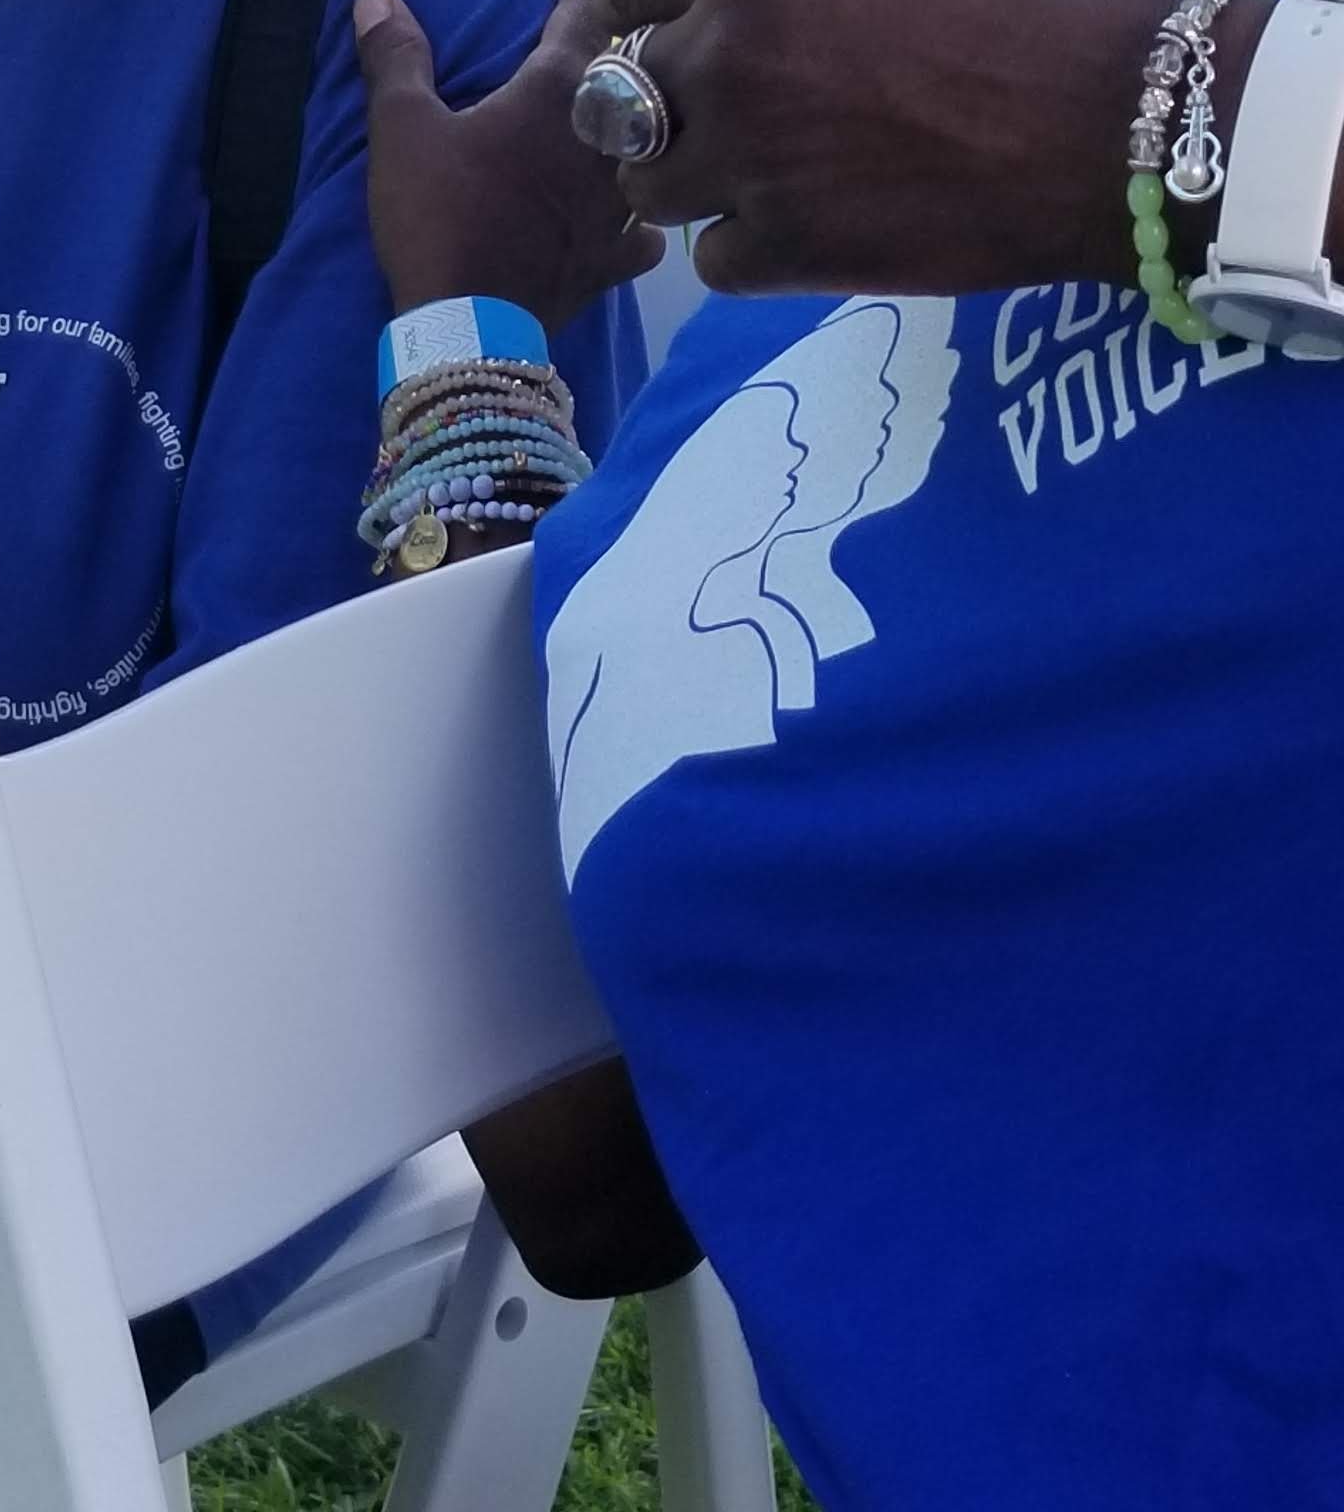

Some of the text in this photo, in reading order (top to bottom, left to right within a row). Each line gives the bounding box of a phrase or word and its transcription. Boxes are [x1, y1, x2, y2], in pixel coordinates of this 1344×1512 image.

[17, 310, 49, 333] for
[52, 317, 88, 337] our
[138, 391, 185, 470] fighting
